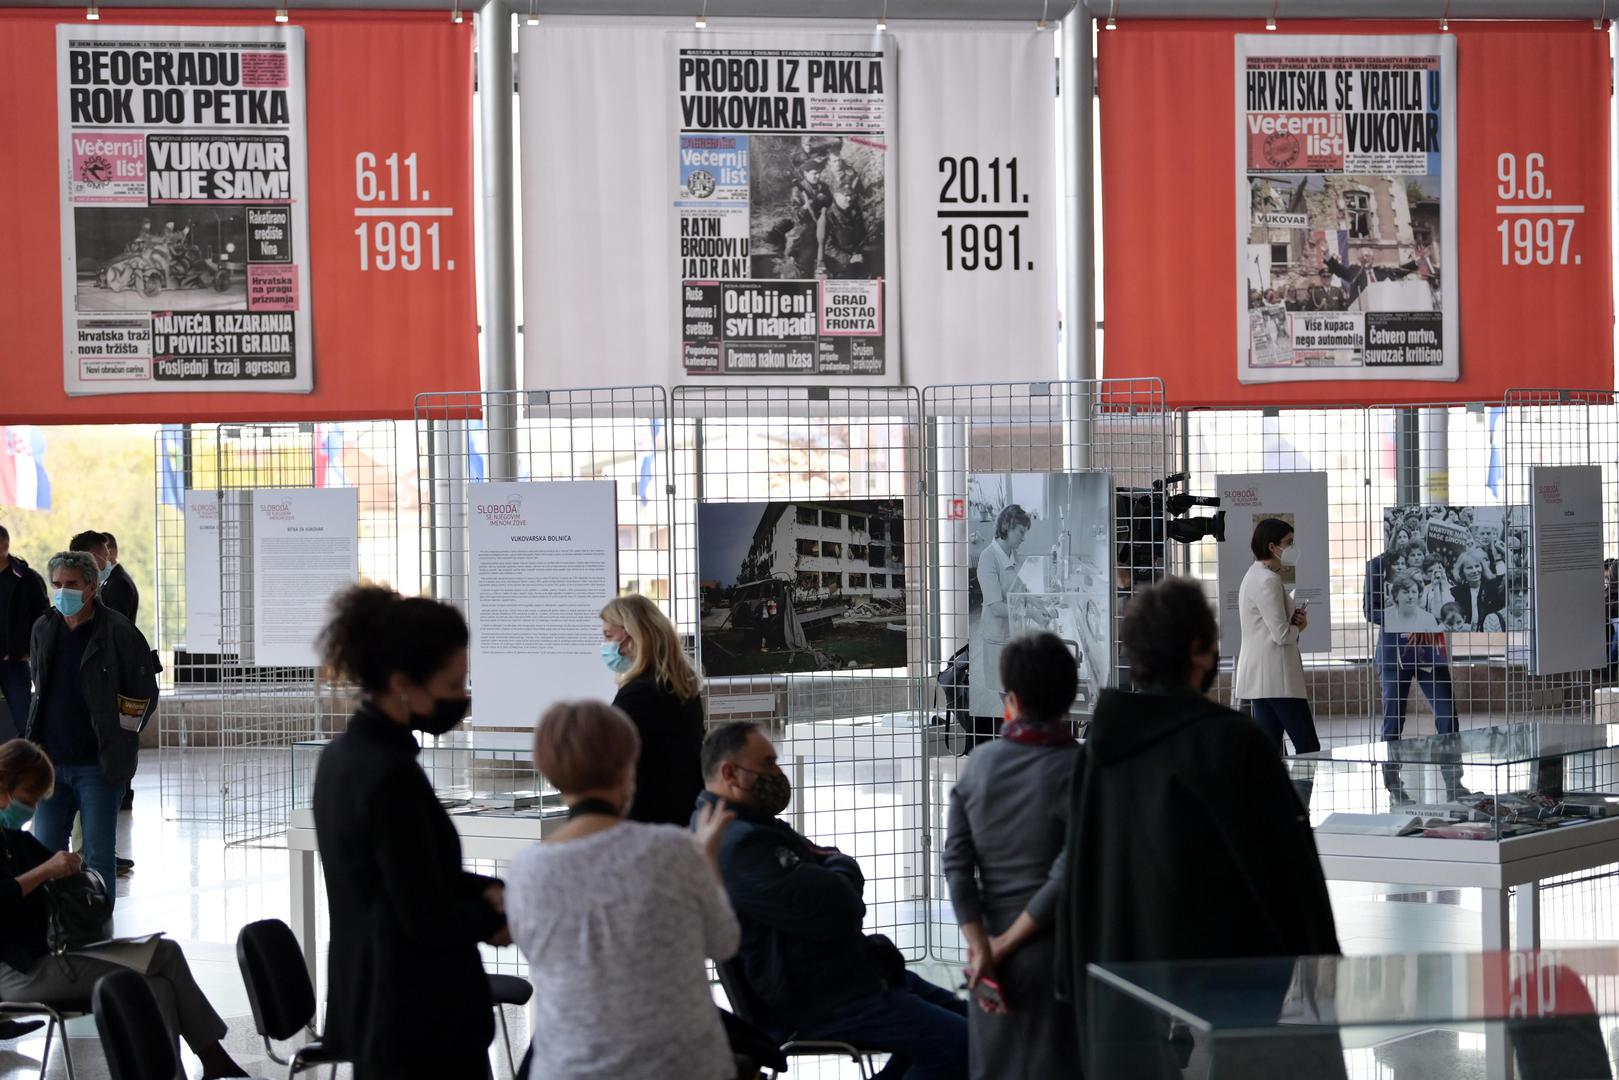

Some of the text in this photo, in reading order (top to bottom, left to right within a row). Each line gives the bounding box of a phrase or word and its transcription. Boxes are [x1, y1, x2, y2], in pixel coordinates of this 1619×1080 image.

[70, 50, 239, 86] BEOGRADU
[680, 58, 884, 94] PROBOJ IZ PAKLA
[1246, 70, 1440, 112] HRVATSKA SE VRATILA U
[70, 88, 290, 124] ROK DO PETKA
[680, 95, 806, 128] VUKOVARA
[1248, 113, 1342, 138] Večernji
[1345, 113, 1440, 152] VUKOVAR
[74, 139, 144, 158] Večernji
[1306, 134, 1342, 156] list
[150, 142, 288, 170] VUKOVAR
[682, 149, 747, 169] Večernji
[116, 160, 144, 177] list
[356, 152, 430, 202] 6.11.
[720, 168, 746, 184] list
[1497, 152, 1552, 200] 9.6.
[150, 171, 289, 200] NIJE SAM!
[939, 156, 1029, 204] 20.11.
[249, 210, 286, 224] Raketirano
[1257, 216, 1306, 224] VUKOVAR
[254, 226, 283, 240] središte
[681, 218, 720, 236] RATNI
[261, 241, 278, 256] Nina
[354, 221, 455, 271] 1991.
[681, 238, 748, 257] BRODOVI U
[942, 224, 1034, 271] 1991.
[1497, 218, 1582, 266] 1997.
[682, 259, 746, 278] JADRAN!
[252, 276, 292, 285] Hrvatska
[266, 286, 292, 294] pragu
[252, 295, 294, 304] priznanja
[724, 289, 813, 317] Odbijeni
[832, 295, 867, 305] GRAD
[686, 304, 717, 318] domove i
[825, 307, 875, 317] POSTAO
[154, 314, 211, 334] NAJVEĆA
[215, 314, 293, 333] RAZARANJA
[726, 312, 816, 339] svi napadi
[826, 319, 875, 329] FRONTA
[1305, 320, 1354, 333] Više kupaca
[78, 330, 150, 342] Hrvatska traži
[155, 334, 290, 354] U POVIJESTI GRADA
[1296, 334, 1363, 347] nego automobila
[1370, 325, 1438, 345] Četvero mrtvo,
[78, 343, 138, 354] nova tržišta
[1365, 346, 1442, 363] suvozač kritično
[728, 349, 812, 368] Drama nakon užasa
[159, 359, 290, 378] Posljednji trzaji agresora
[477, 504, 518, 514] SLOBODA
